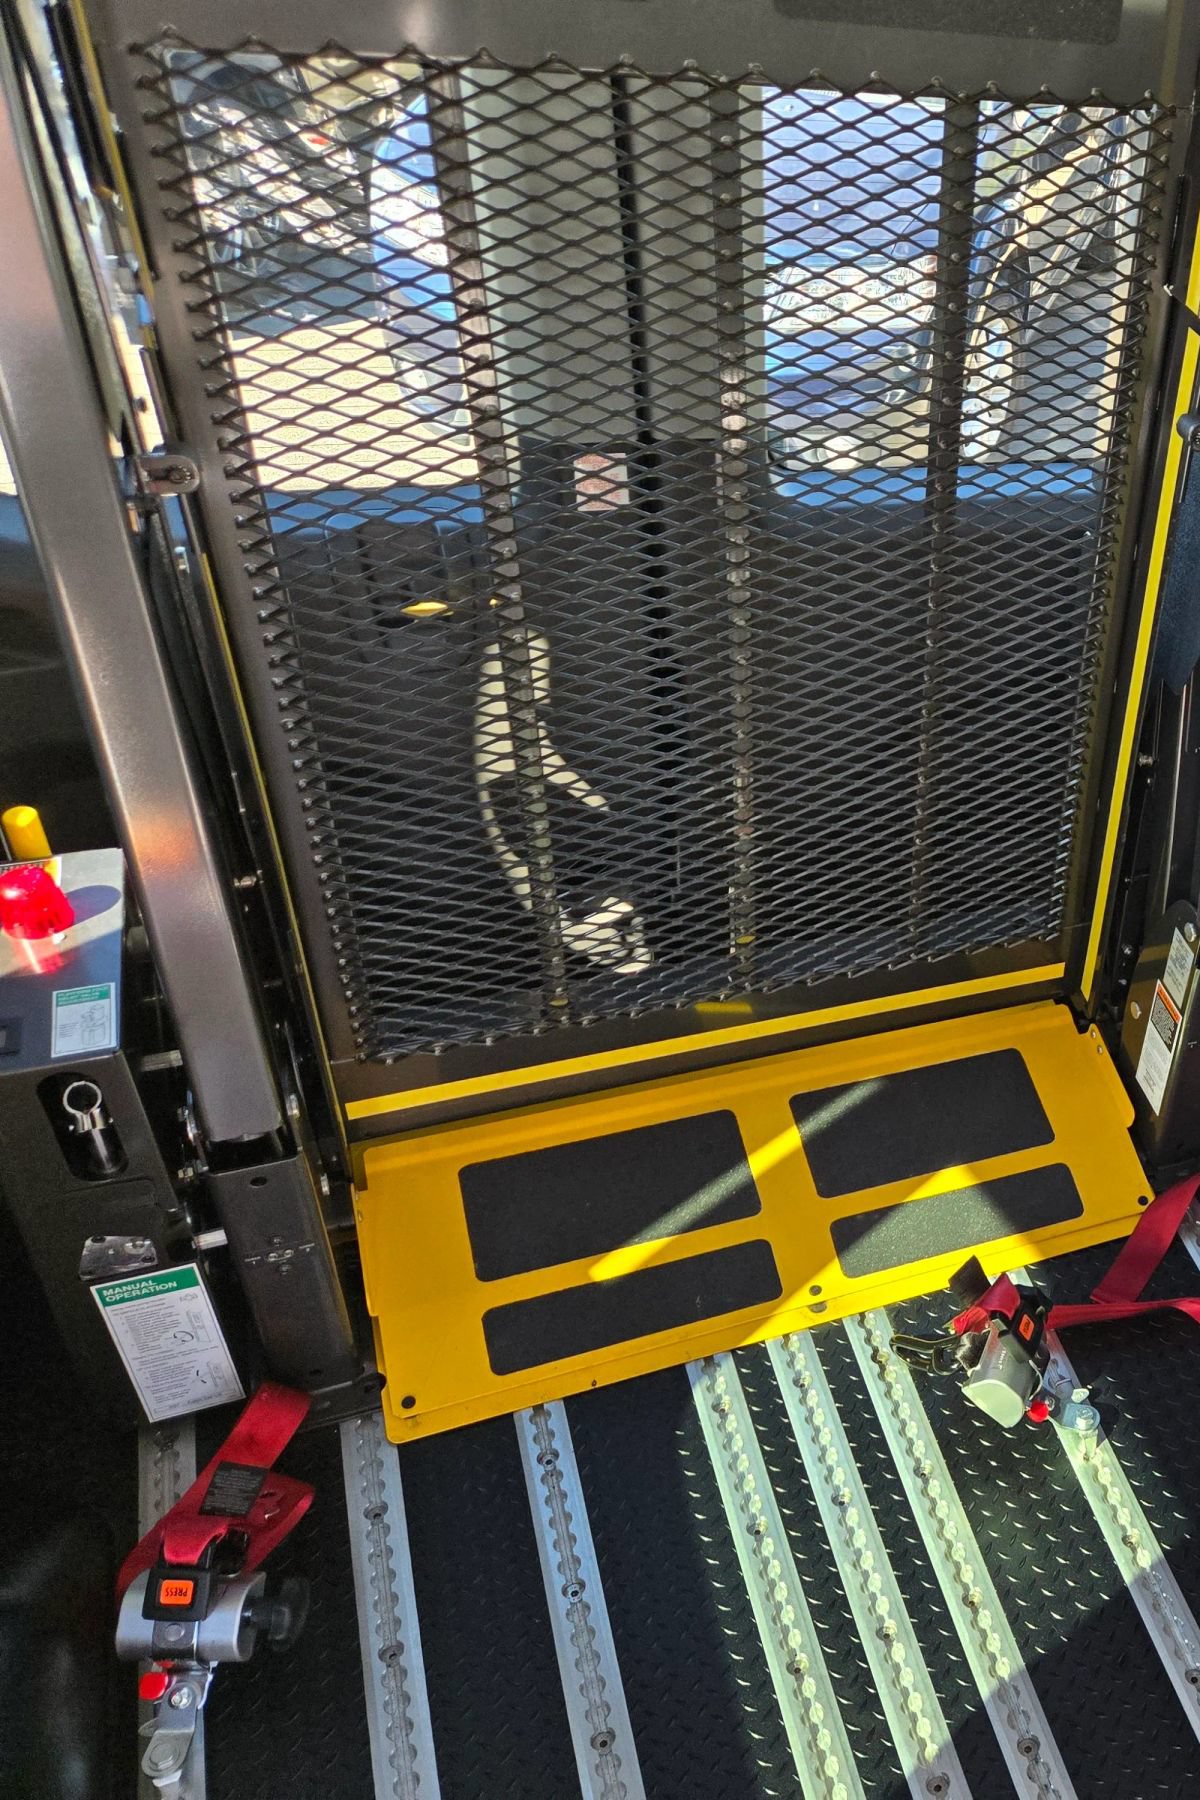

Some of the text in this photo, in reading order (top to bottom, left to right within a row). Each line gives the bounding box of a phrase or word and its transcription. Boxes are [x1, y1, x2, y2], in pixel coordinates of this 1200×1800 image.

[102, 1280, 157, 1297] MANUAL
[105, 1281, 178, 1302] OPERATION
[165, 1587, 188, 1597] PRESS
